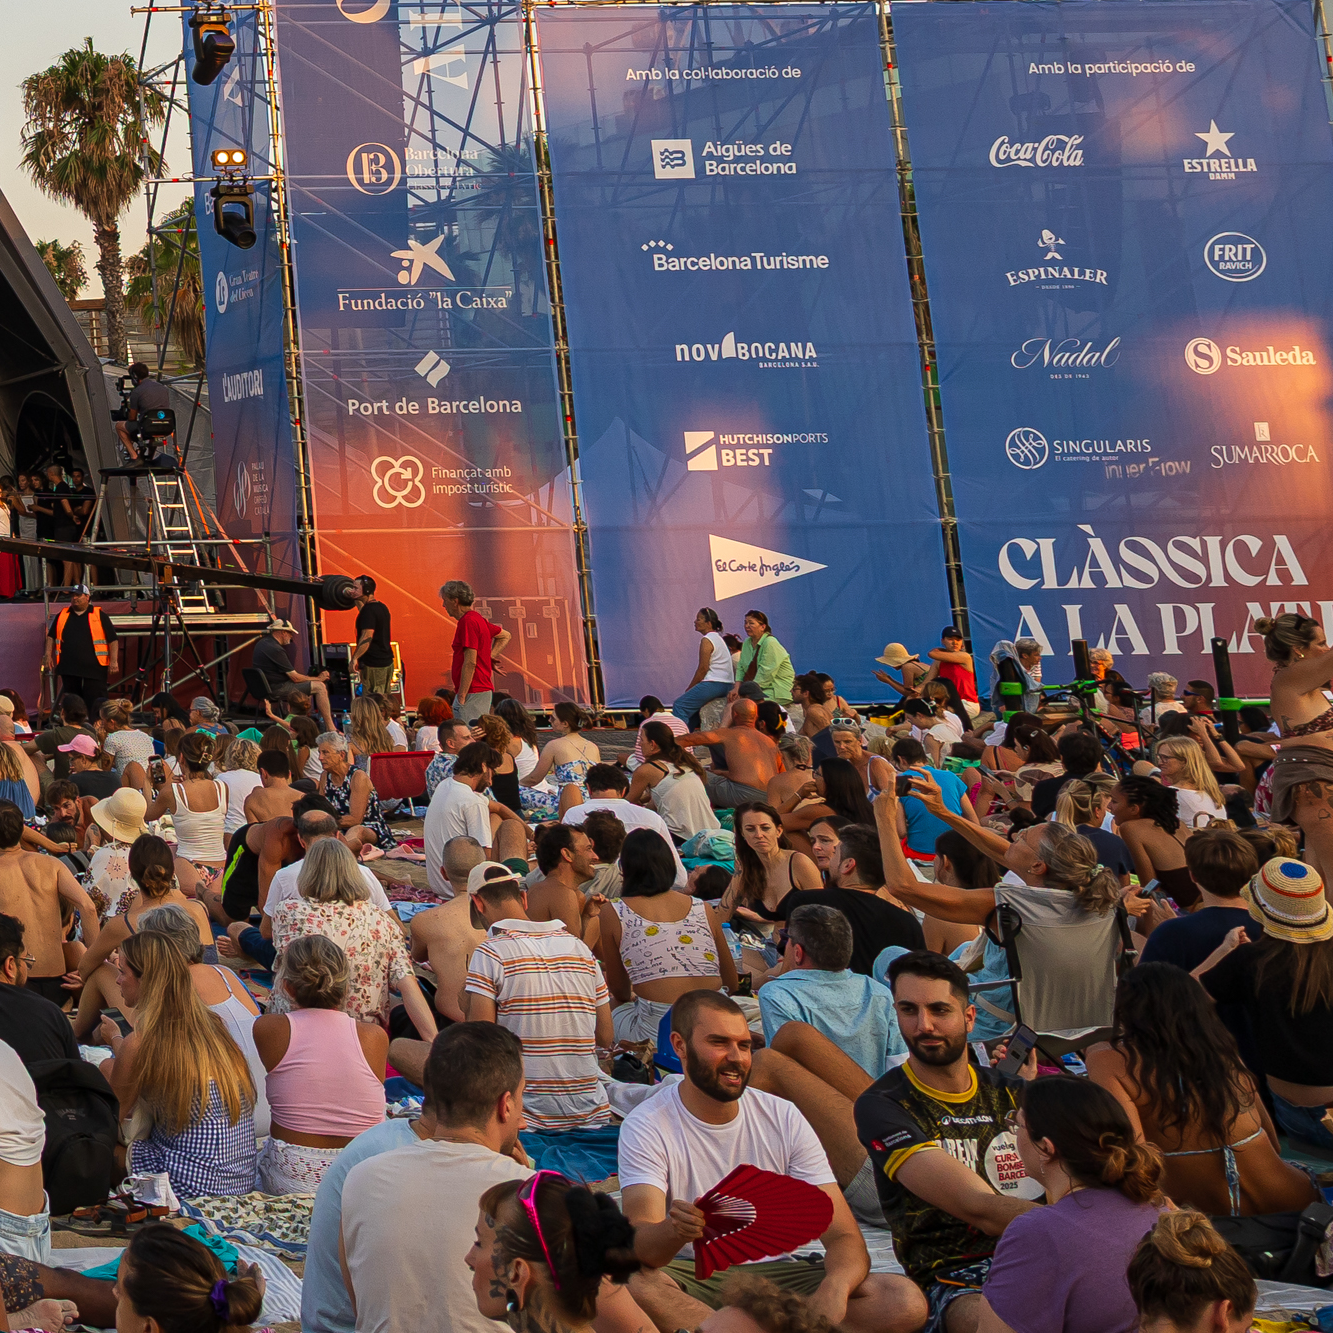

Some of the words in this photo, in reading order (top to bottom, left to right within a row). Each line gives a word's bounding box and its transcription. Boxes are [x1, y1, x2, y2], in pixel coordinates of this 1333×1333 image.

[413, 44, 468, 90] A
[625, 68, 662, 81] Amb
[665, 68, 679, 80] la
[782, 66, 801, 78] de
[1029, 61, 1064, 74] Amb
[1067, 61, 1081, 74] la
[1085, 59, 1173, 77] participació
[1176, 61, 1196, 72] de
[404, 146, 478, 160] Barcelona
[702, 141, 764, 158] Aigües
[769, 141, 792, 155] de
[989, 134, 1084, 167] Coca-Cola
[405, 164, 474, 177] Obertura
[705, 160, 797, 176] Barcelona
[1183, 158, 1257, 173] ESTRELLA
[1209, 172, 1236, 180] DAMM
[1214, 244, 1255, 261] FRIT
[653, 253, 751, 271] Barcelona
[752, 252, 829, 270] Turisme
[1219, 262, 1252, 270] RAVICH
[1005, 266, 1108, 287] ESPINALER
[338, 292, 425, 311] Fundació
[1010, 336, 1121, 369] Nadal
[1226, 346, 1317, 366] Sauleda
[222, 369, 264, 403] L'AUDITORI
[347, 399, 389, 415] Port
[394, 397, 419, 414] de
[427, 396, 522, 414] Barcelona
[1053, 439, 1151, 454] SINGULARIS
[722, 448, 773, 467] BEST
[1063, 455, 1090, 463] catering
[1210, 444, 1320, 471] SUMARROCA
[432, 467, 482, 481] Finançat
[485, 466, 511, 478] amb
[433, 483, 471, 496] impost
[474, 481, 513, 494] turístic
[998, 524, 1309, 590] CLÀSSICA
[715, 559, 728, 572] El
[728, 559, 757, 572] Corte
[759, 556, 801, 577] Inglés
[1013, 605, 1055, 656] A
[1061, 604, 1150, 655] LA
[997, 1161, 1025, 1172] BOMBE
[1000, 1182, 1019, 1190] 2025
